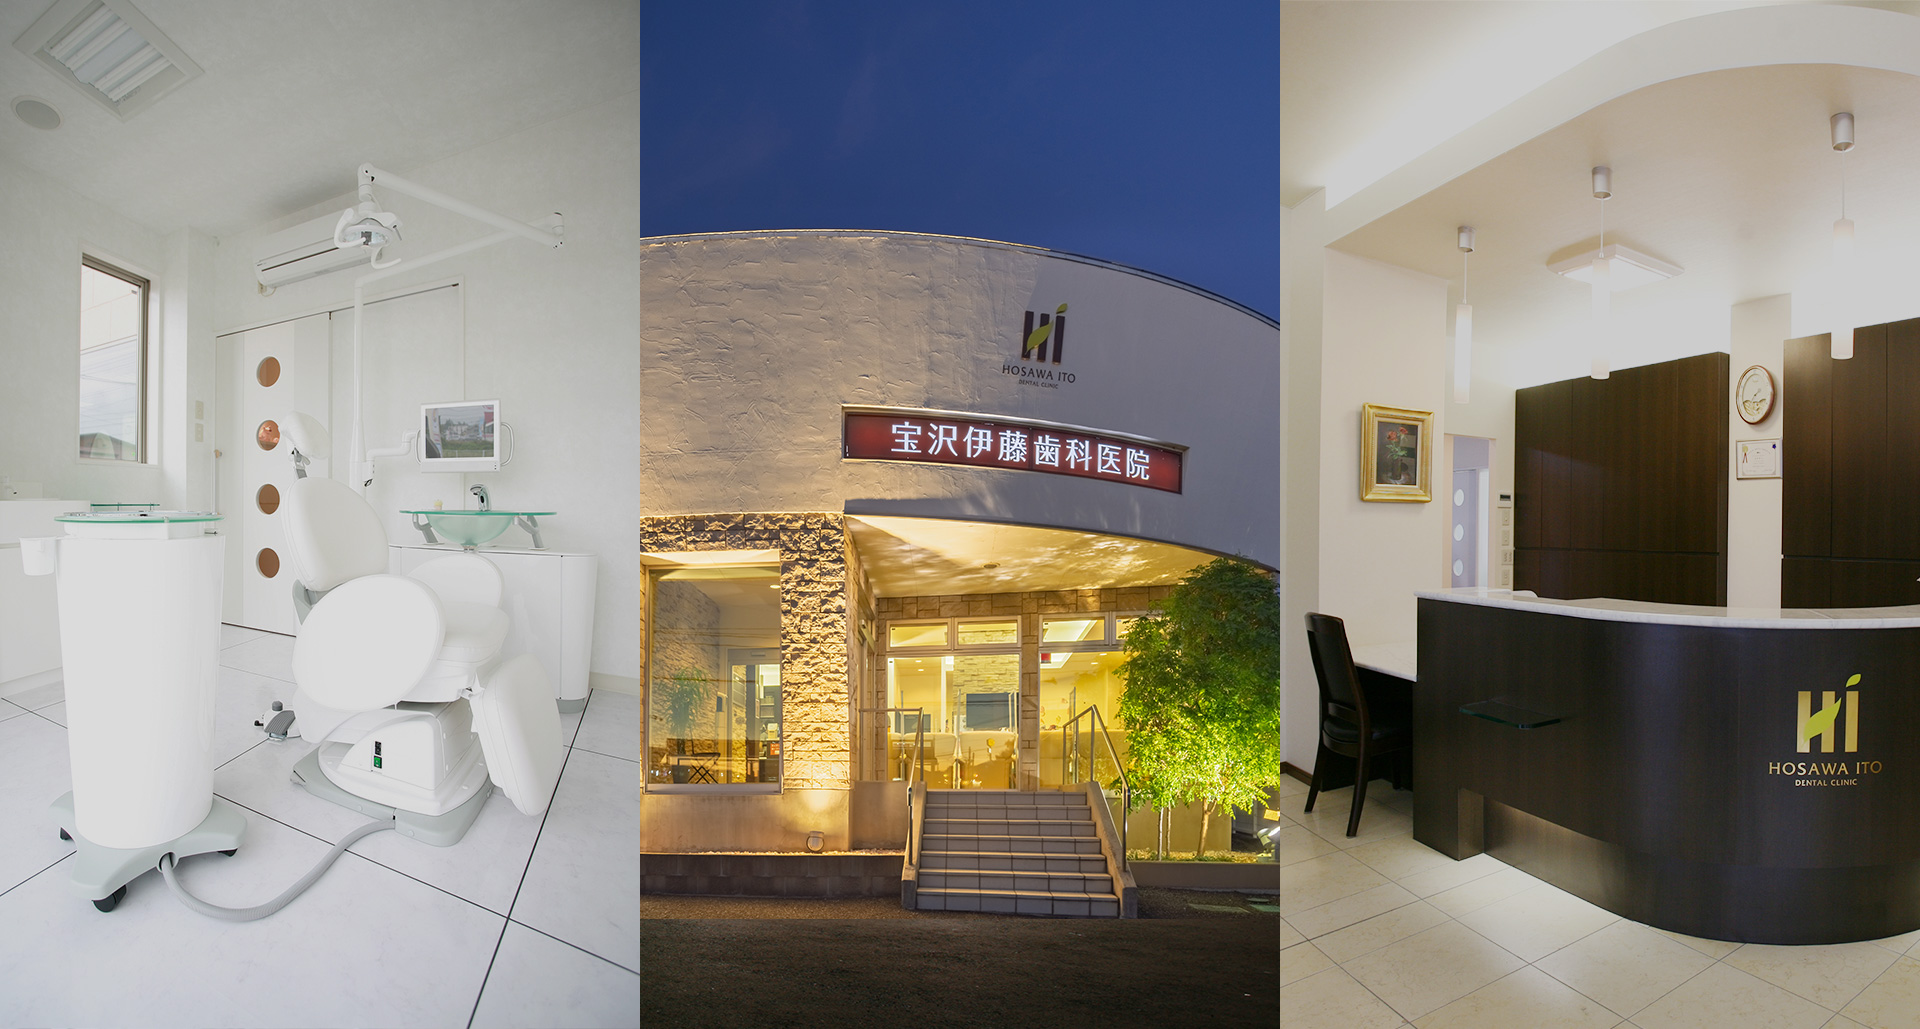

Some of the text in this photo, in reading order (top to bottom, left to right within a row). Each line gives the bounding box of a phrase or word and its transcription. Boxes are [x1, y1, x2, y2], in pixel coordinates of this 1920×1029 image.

[1002, 364, 1076, 384] HOSAWA ITO
[1018, 379, 1059, 389] DENTAL CLINIC
[891, 421, 1150, 481] 宝沢伊藤歯科医院
[1769, 760, 1883, 776] HOSAWA ITO
[1795, 778, 1858, 787] DENTAL CLINIC
